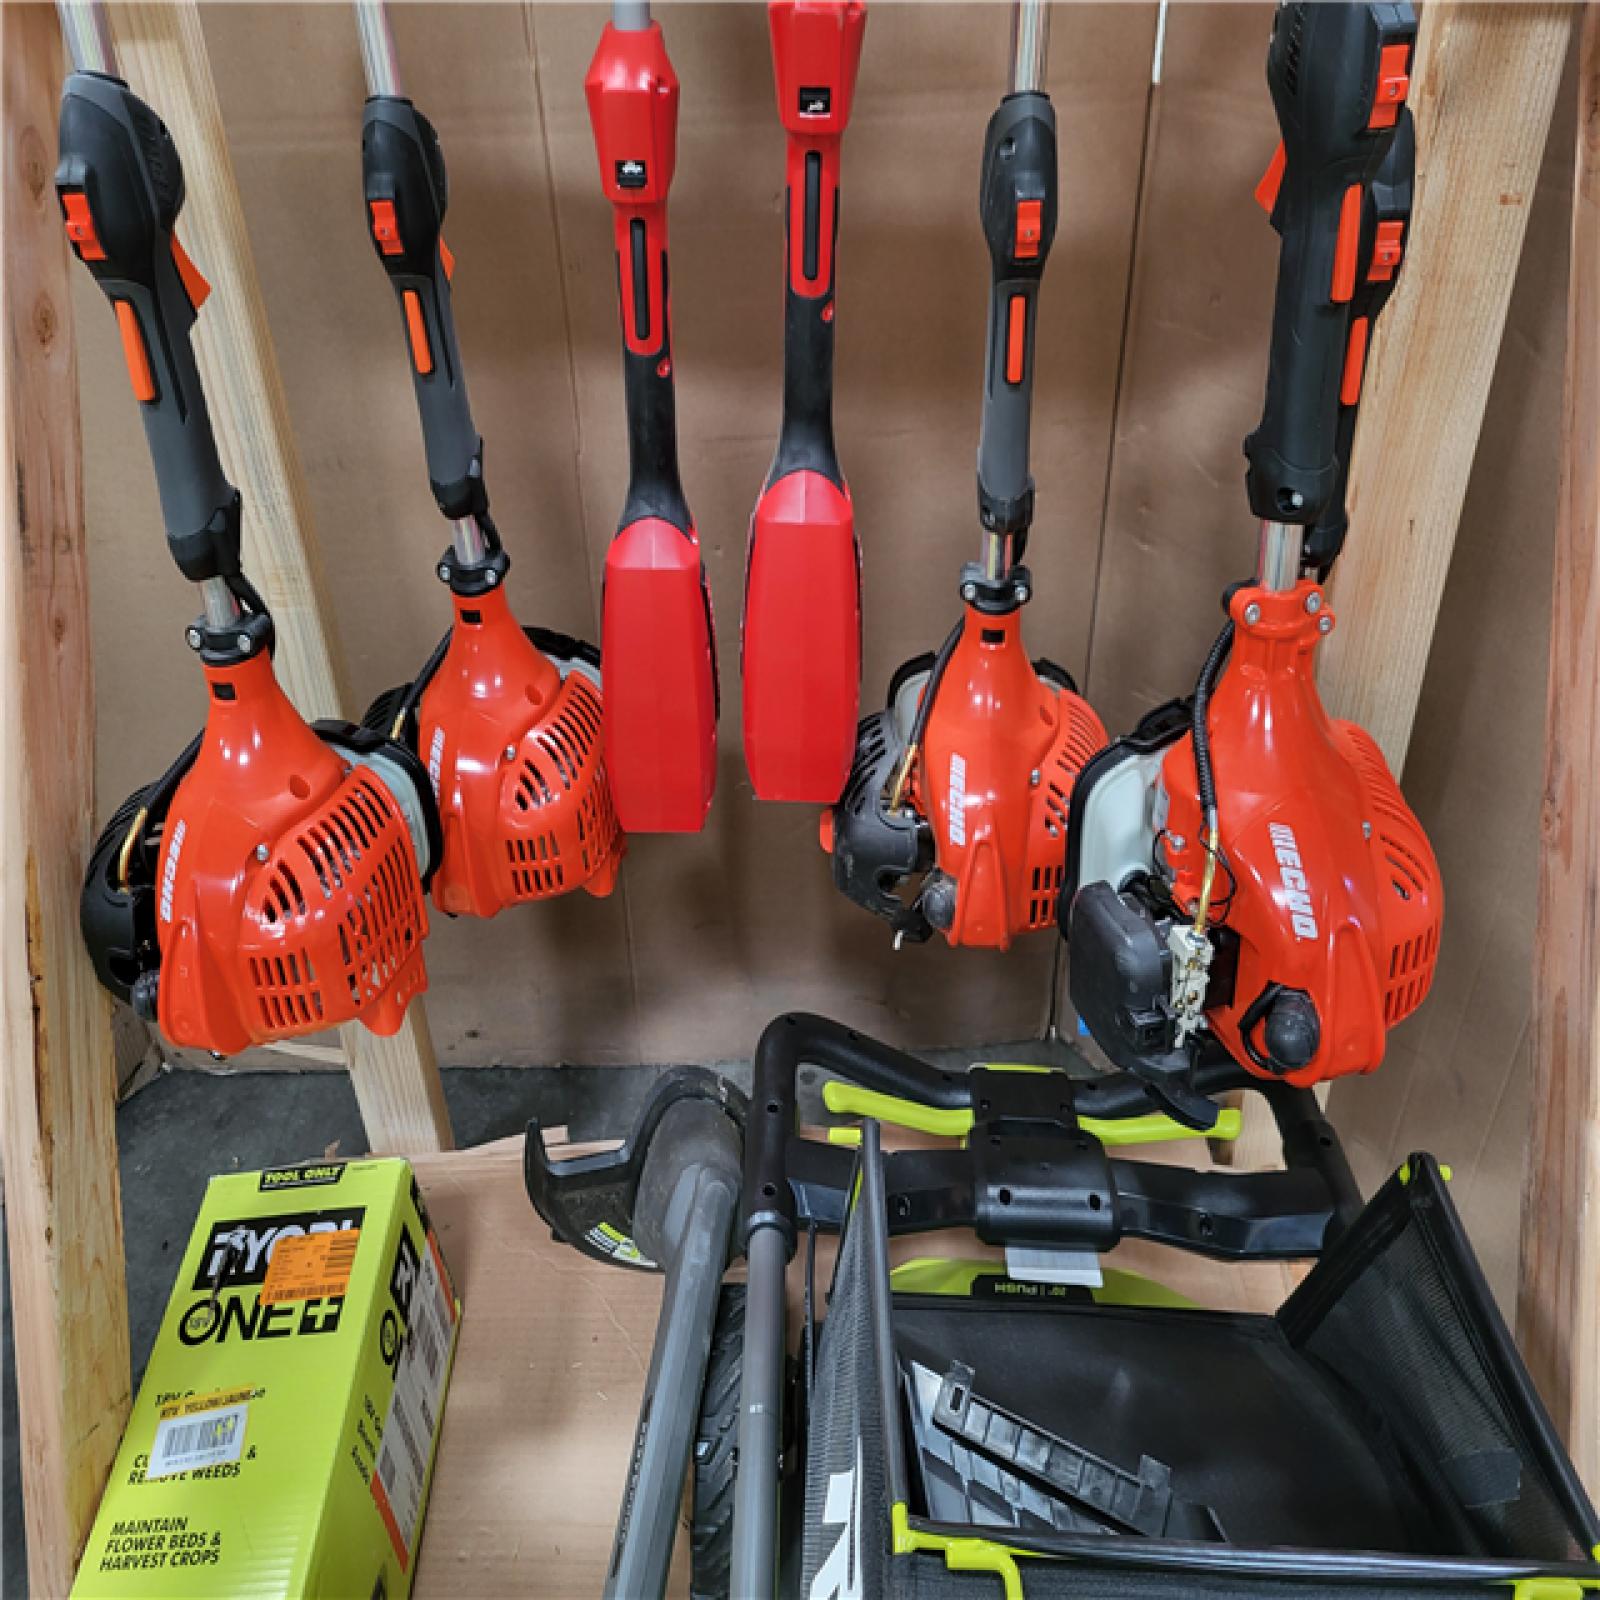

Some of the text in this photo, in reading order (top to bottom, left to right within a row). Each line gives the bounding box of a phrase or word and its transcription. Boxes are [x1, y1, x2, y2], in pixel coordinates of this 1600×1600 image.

[949, 771, 967, 847] ECHO
[1274, 847, 1319, 939] ECHO
[264, 1170, 299, 1184] TOOL
[304, 1166, 341, 1180] ONLY
[191, 1462, 241, 1480] WEEDS
[110, 1516, 188, 1535] MAINTAIN
[105, 1530, 220, 1552] FLOWER BEDS &
[99, 1548, 220, 1572] HARVEST CROPS
